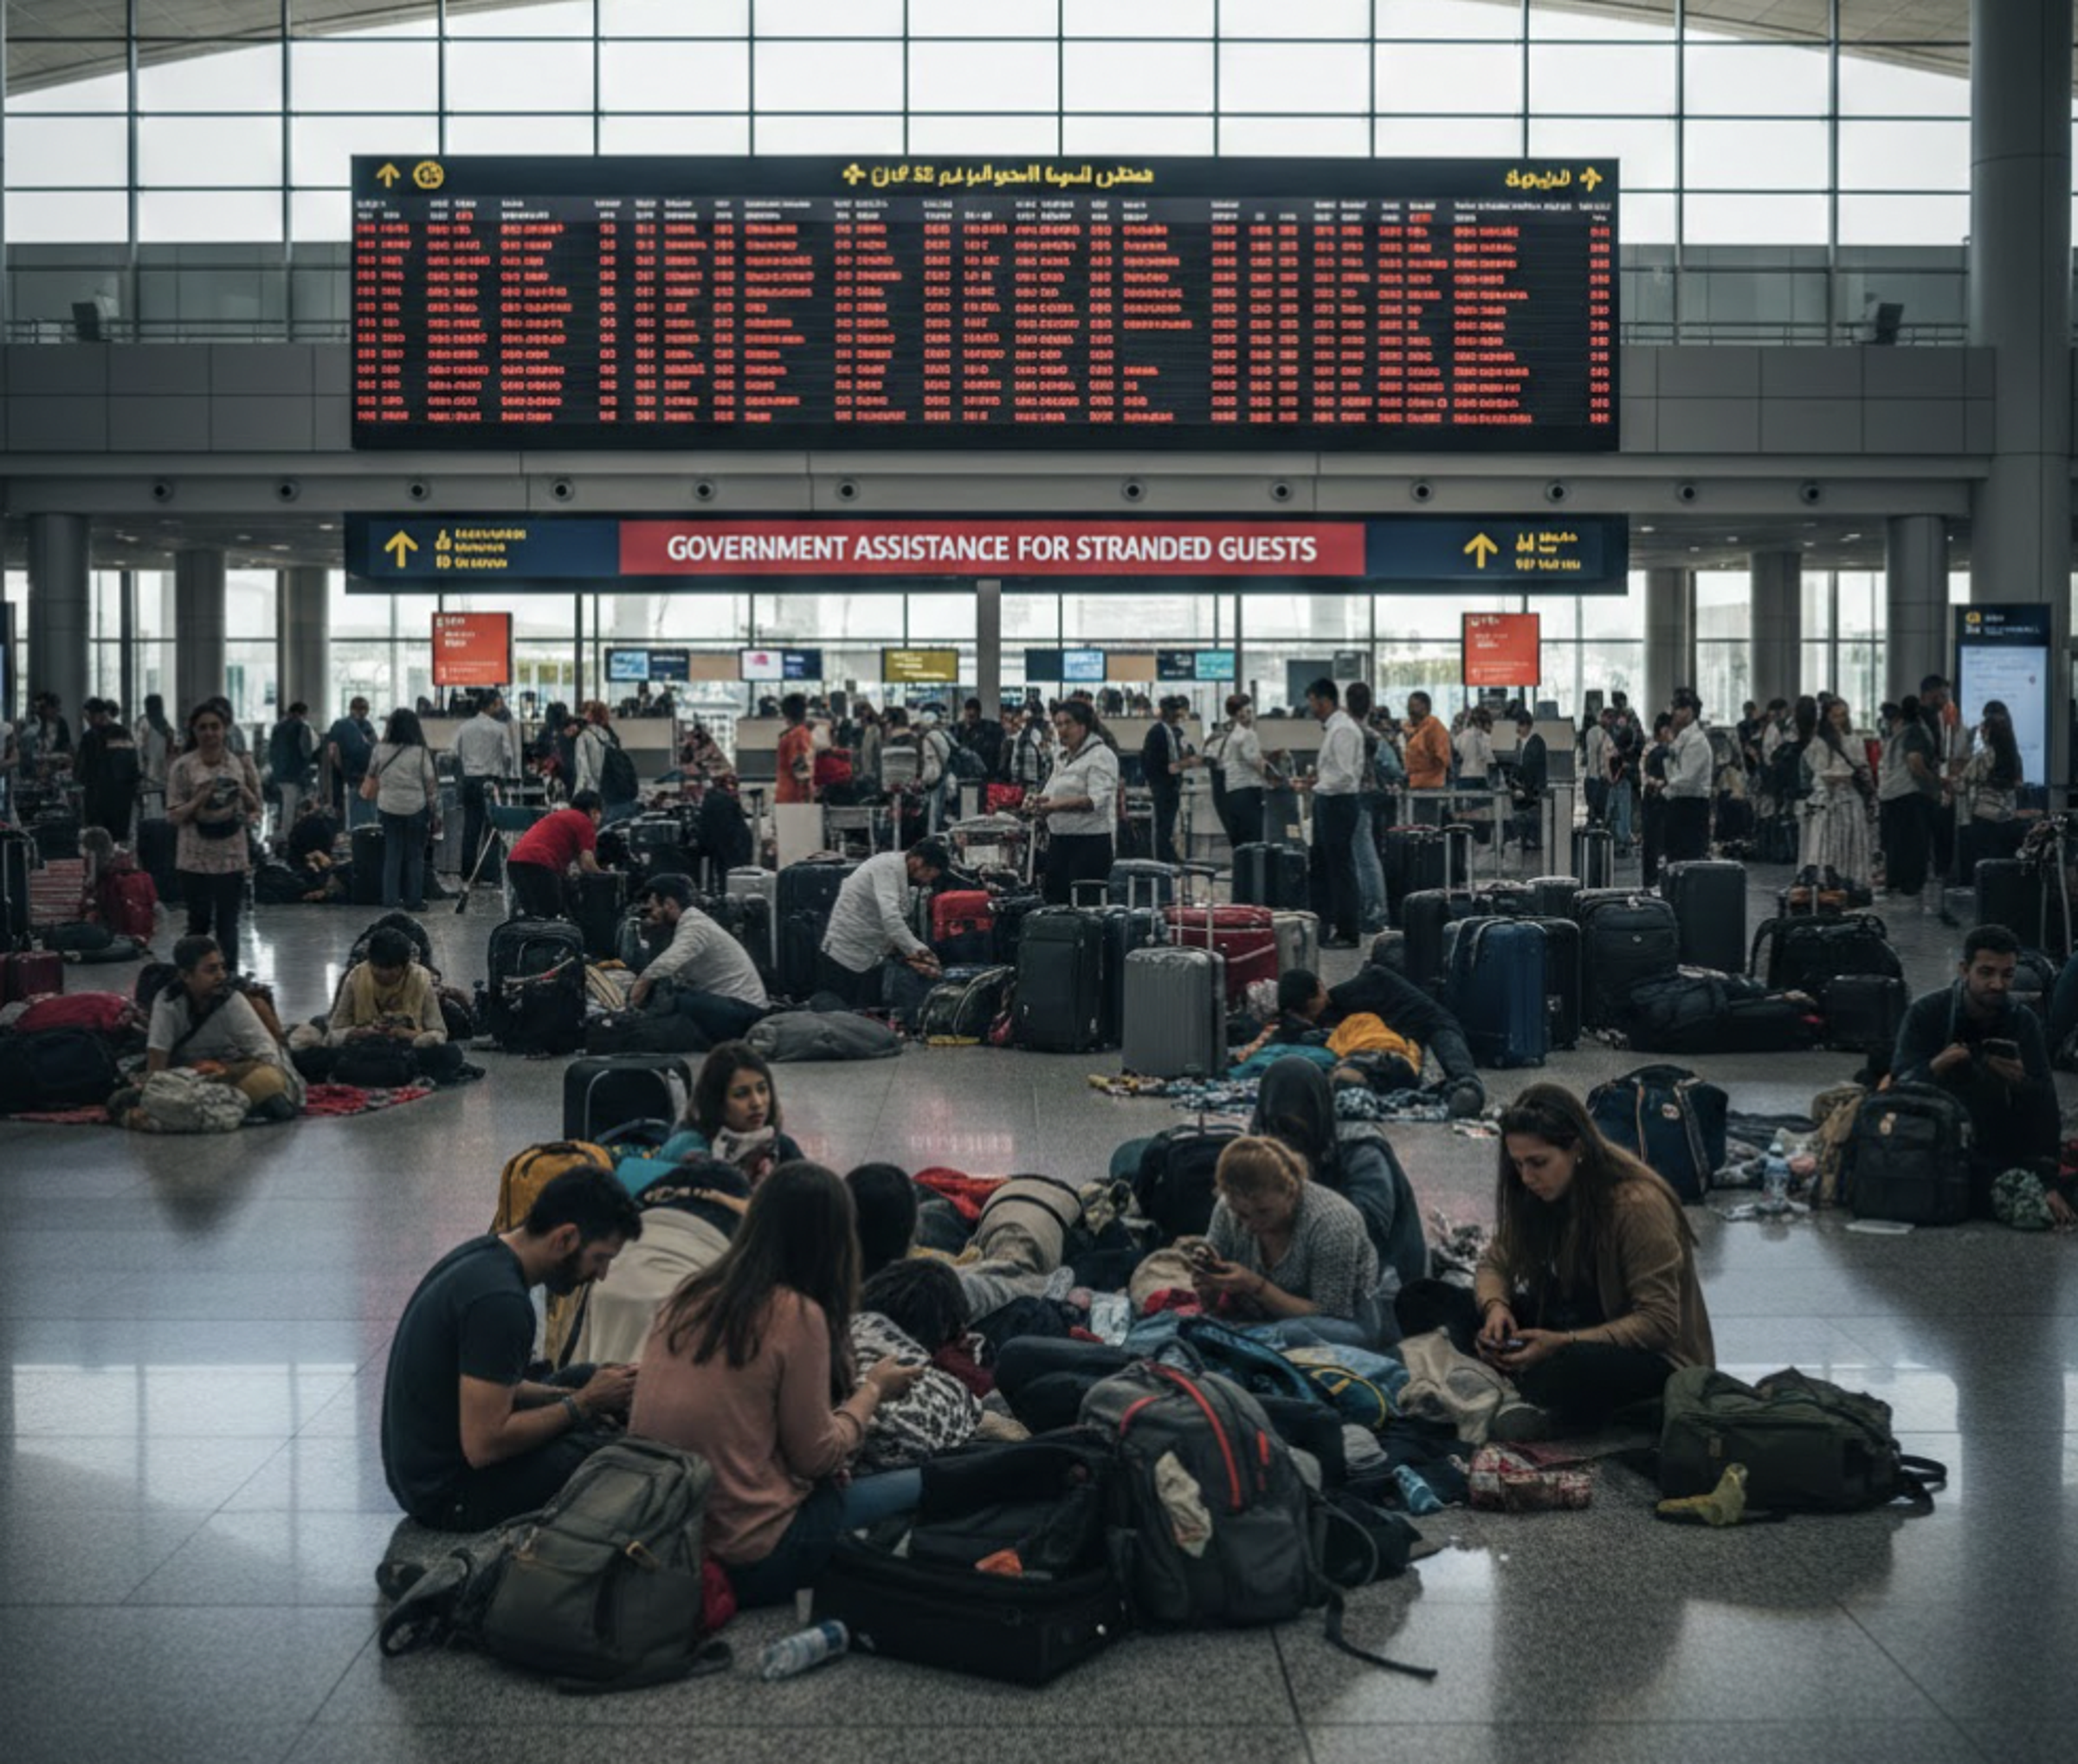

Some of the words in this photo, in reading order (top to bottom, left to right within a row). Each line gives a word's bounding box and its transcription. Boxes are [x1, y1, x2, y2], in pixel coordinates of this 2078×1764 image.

[667, 535, 848, 560] GOVERNMENT
[854, 535, 1010, 560] ASSISTANCE
[1017, 535, 1070, 560] FOR
[1076, 535, 1212, 561] STRANDED
[1218, 535, 1317, 561] GUESTS
